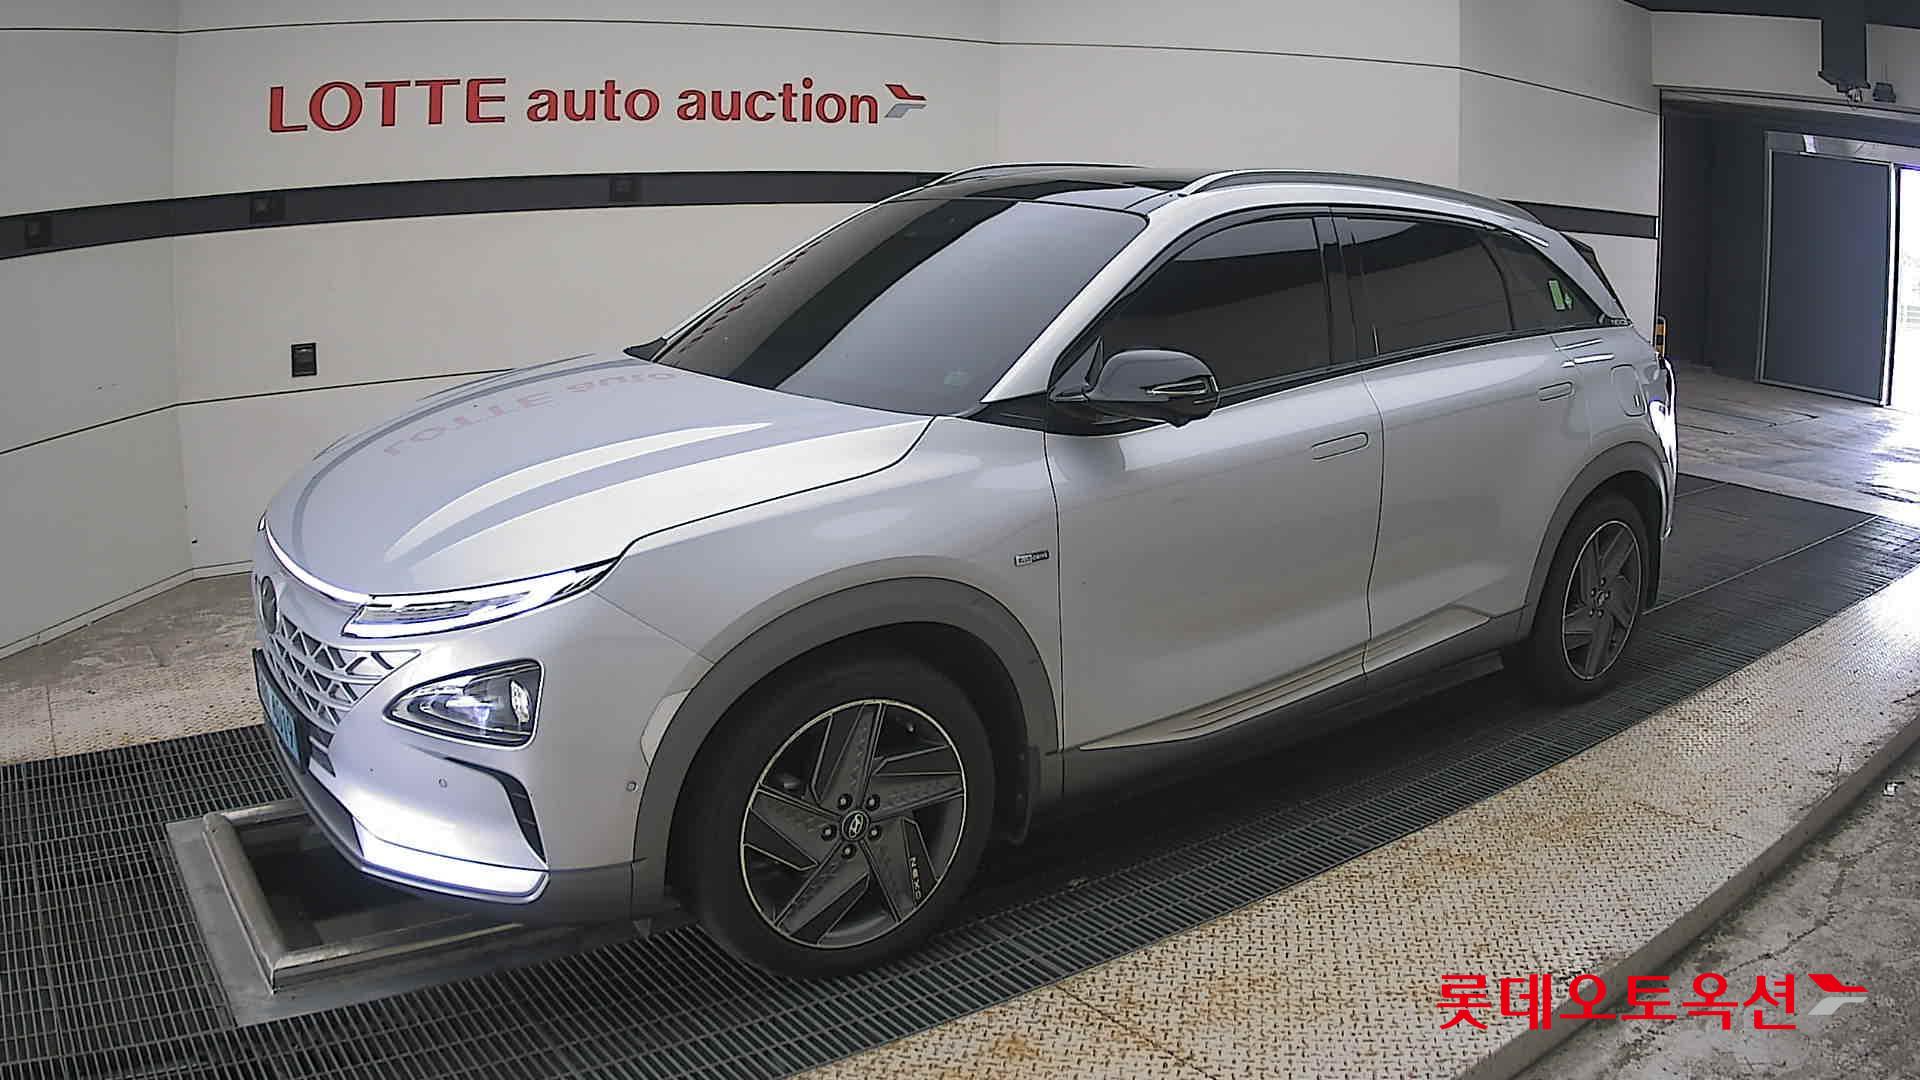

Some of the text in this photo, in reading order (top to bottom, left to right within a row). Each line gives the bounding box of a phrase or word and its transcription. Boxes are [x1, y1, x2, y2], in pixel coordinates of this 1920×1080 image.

[269, 77, 880, 132] LOTTE auto auction
